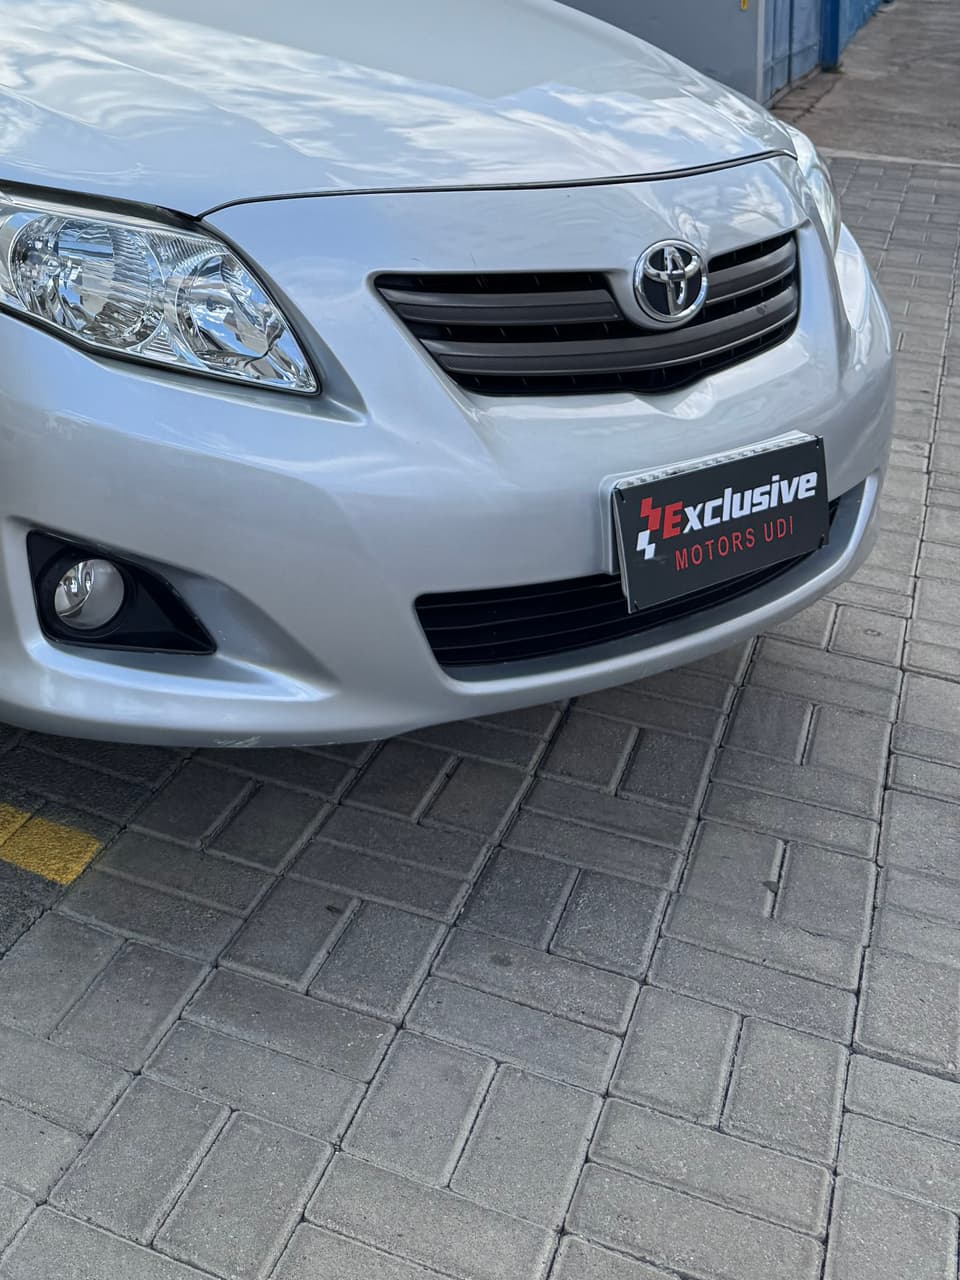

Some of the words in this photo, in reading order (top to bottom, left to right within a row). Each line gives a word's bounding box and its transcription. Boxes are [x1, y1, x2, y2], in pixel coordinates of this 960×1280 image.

[662, 471, 818, 540] Exclusive
[674, 527, 756, 571] MOTORS
[763, 515, 794, 543] UDI
